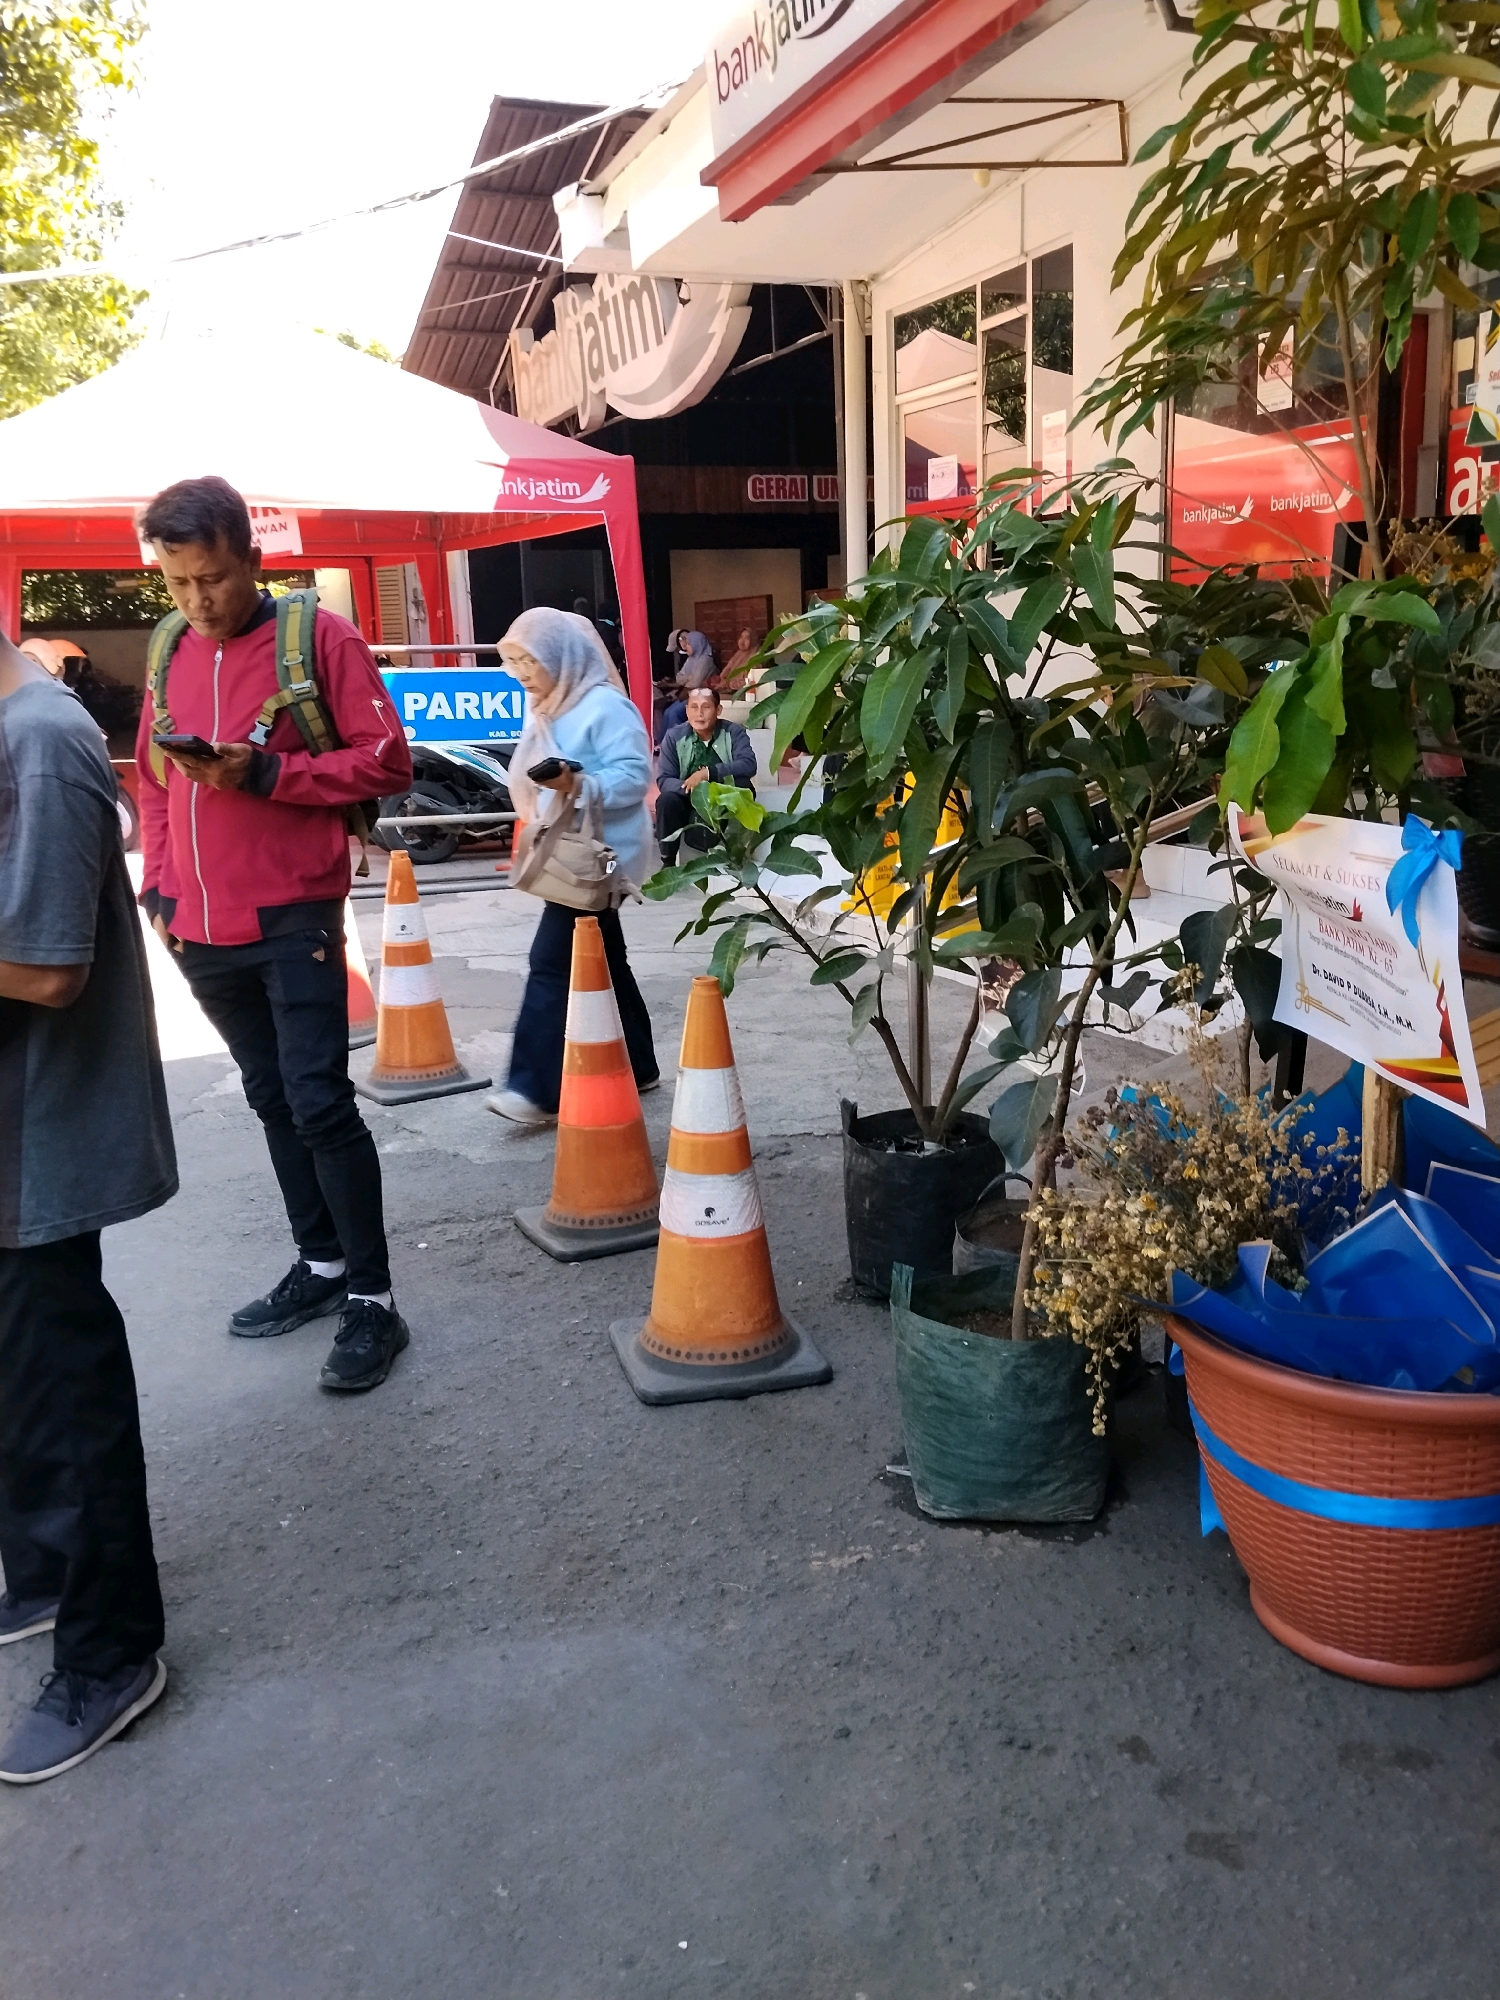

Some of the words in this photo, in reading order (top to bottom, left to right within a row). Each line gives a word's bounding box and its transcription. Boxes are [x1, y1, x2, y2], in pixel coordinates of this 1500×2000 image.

[512, 273, 664, 418] bankjatim
[499, 477, 581, 501] ankjatim
[751, 476, 807, 500] GERAI
[1183, 502, 1236, 525] bankjatim
[1271, 489, 1333, 513] bankjatim
[403, 691, 526, 721] PARKI
[1272, 853, 1320, 879] SELAMAT
[1323, 865, 1333, 881] &
[1336, 867, 1381, 892] SUKSES
[1318, 917, 1341, 942] BANK
[1340, 929, 1365, 957] JATIM
[1384, 957, 1394, 977] 65
[1311, 963, 1322, 978] Dr.
[1323, 968, 1345, 988] DAVID
